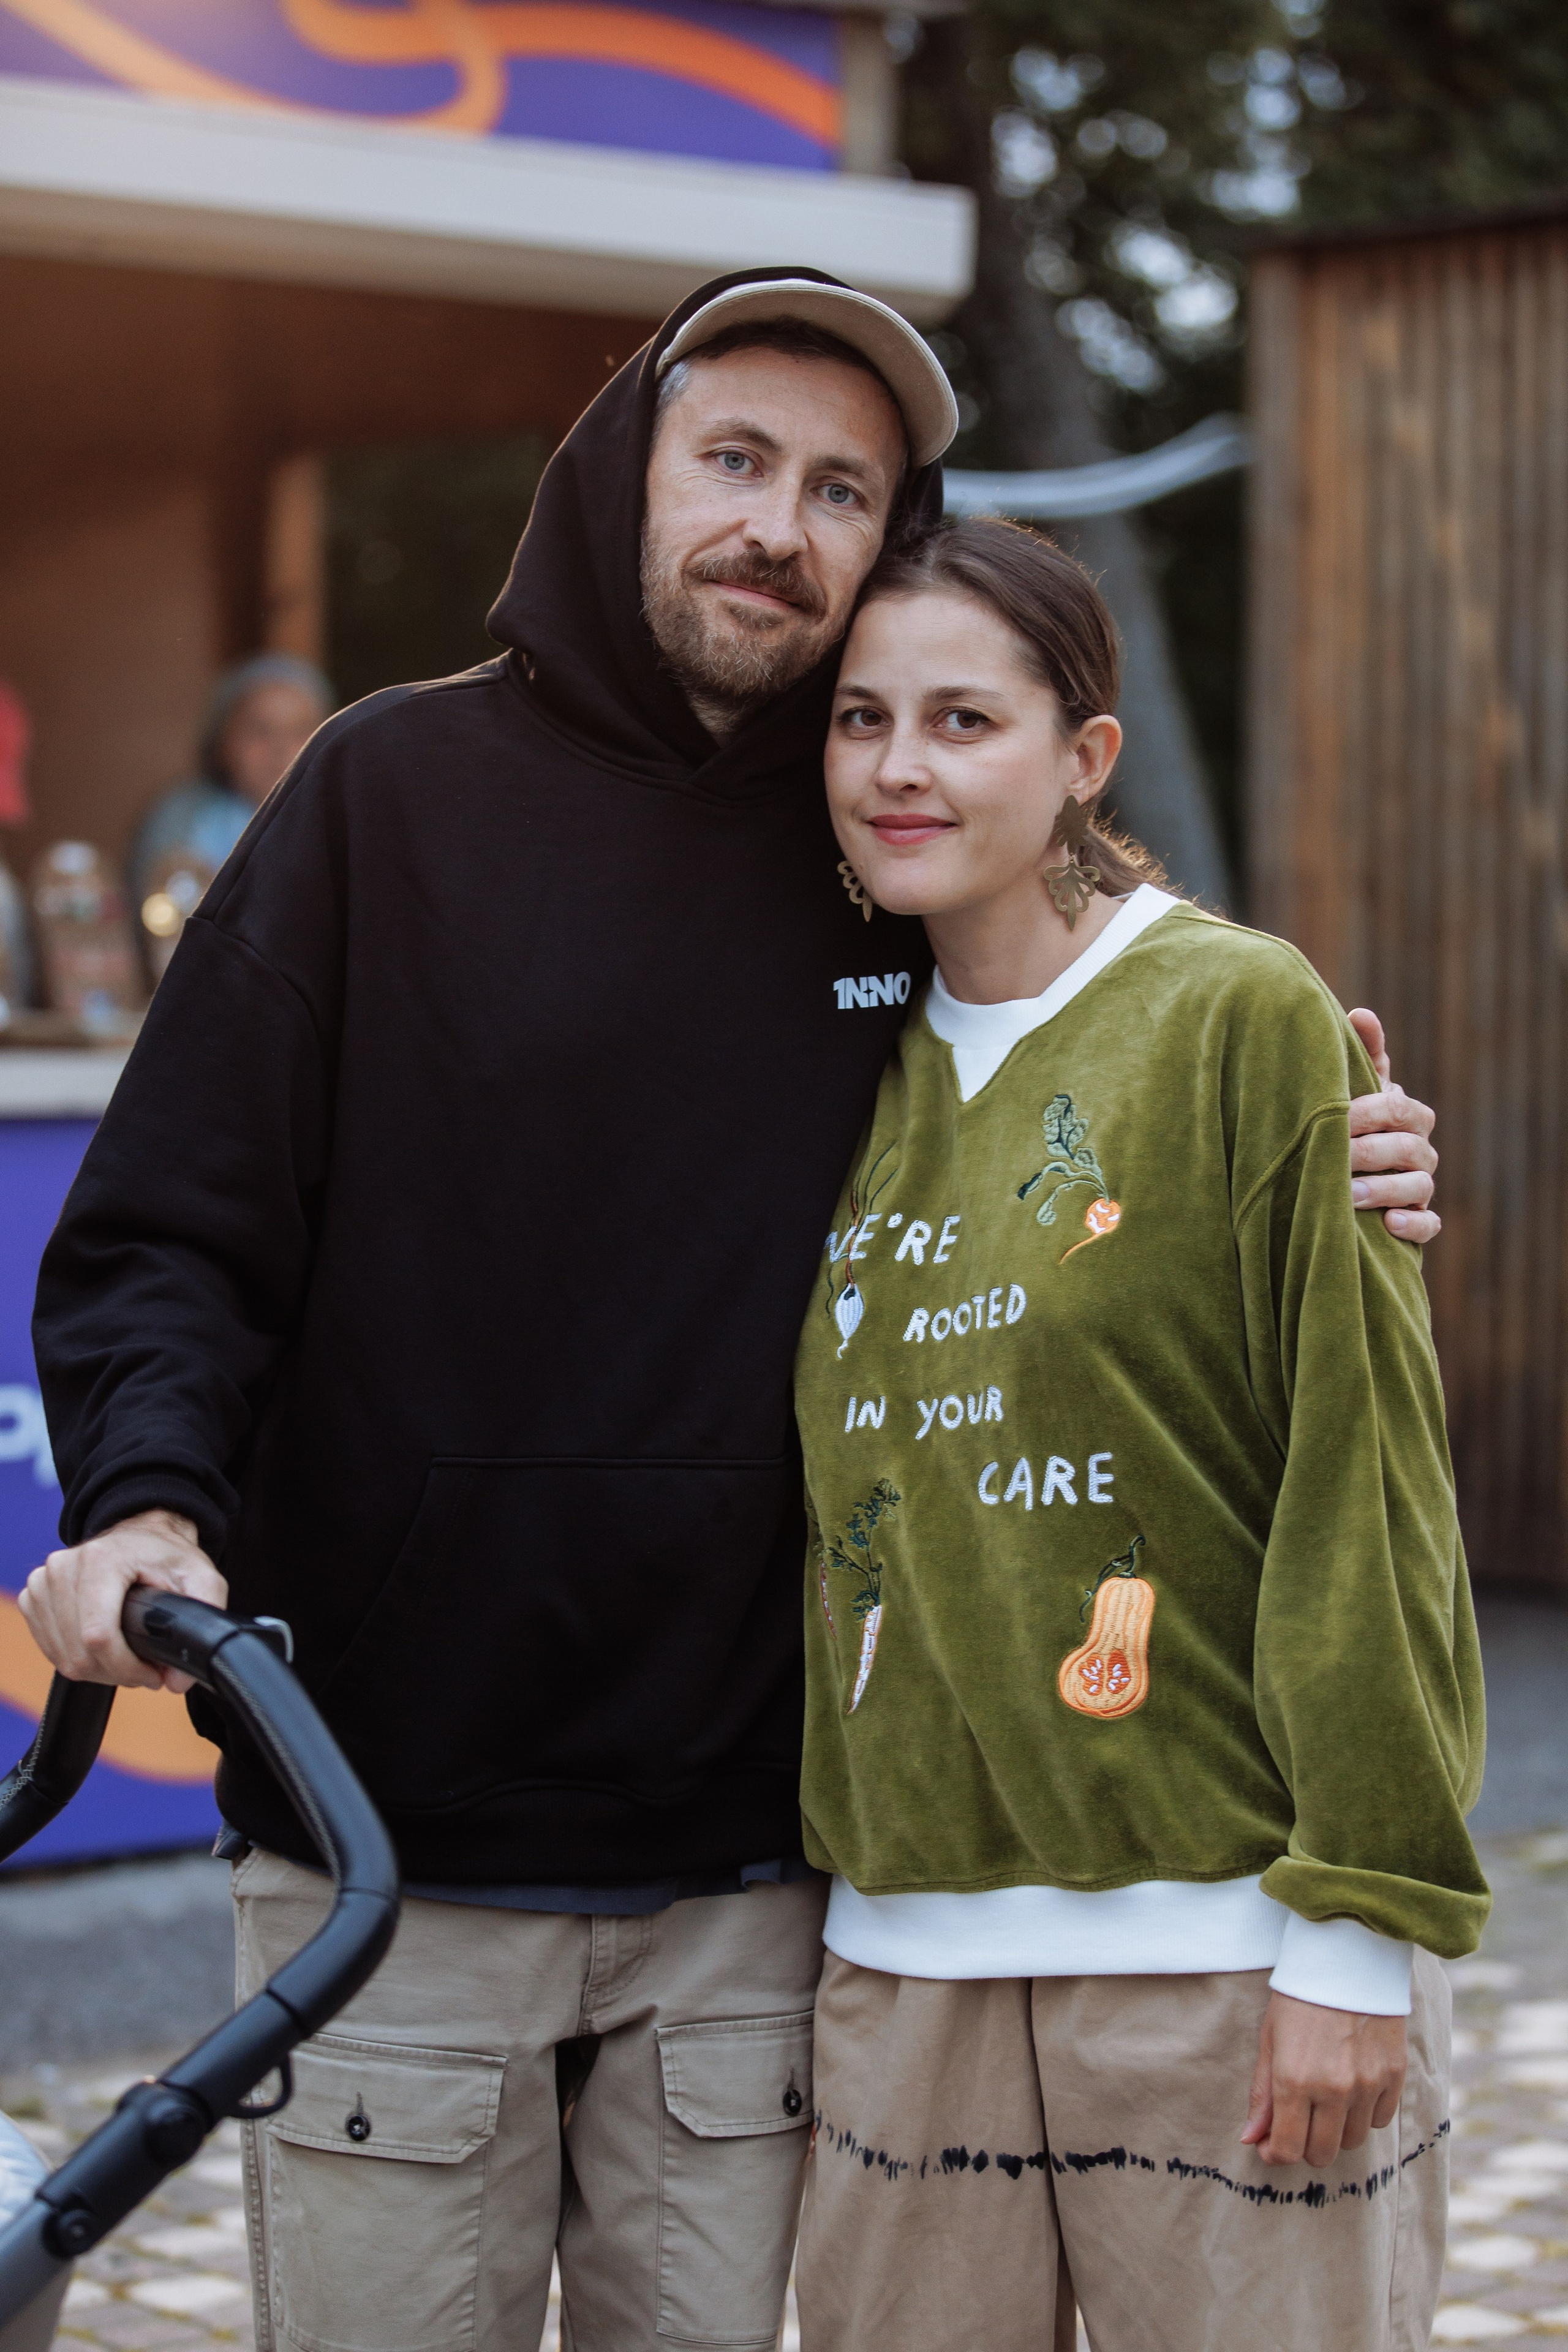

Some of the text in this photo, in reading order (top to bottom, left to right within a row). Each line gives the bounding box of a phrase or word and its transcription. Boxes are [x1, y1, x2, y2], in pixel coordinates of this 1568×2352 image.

[903, 1283, 1027, 1343] ROOTED
[845, 1384, 1004, 1440] IN YOUR
[978, 1452, 1115, 1511] CARE
